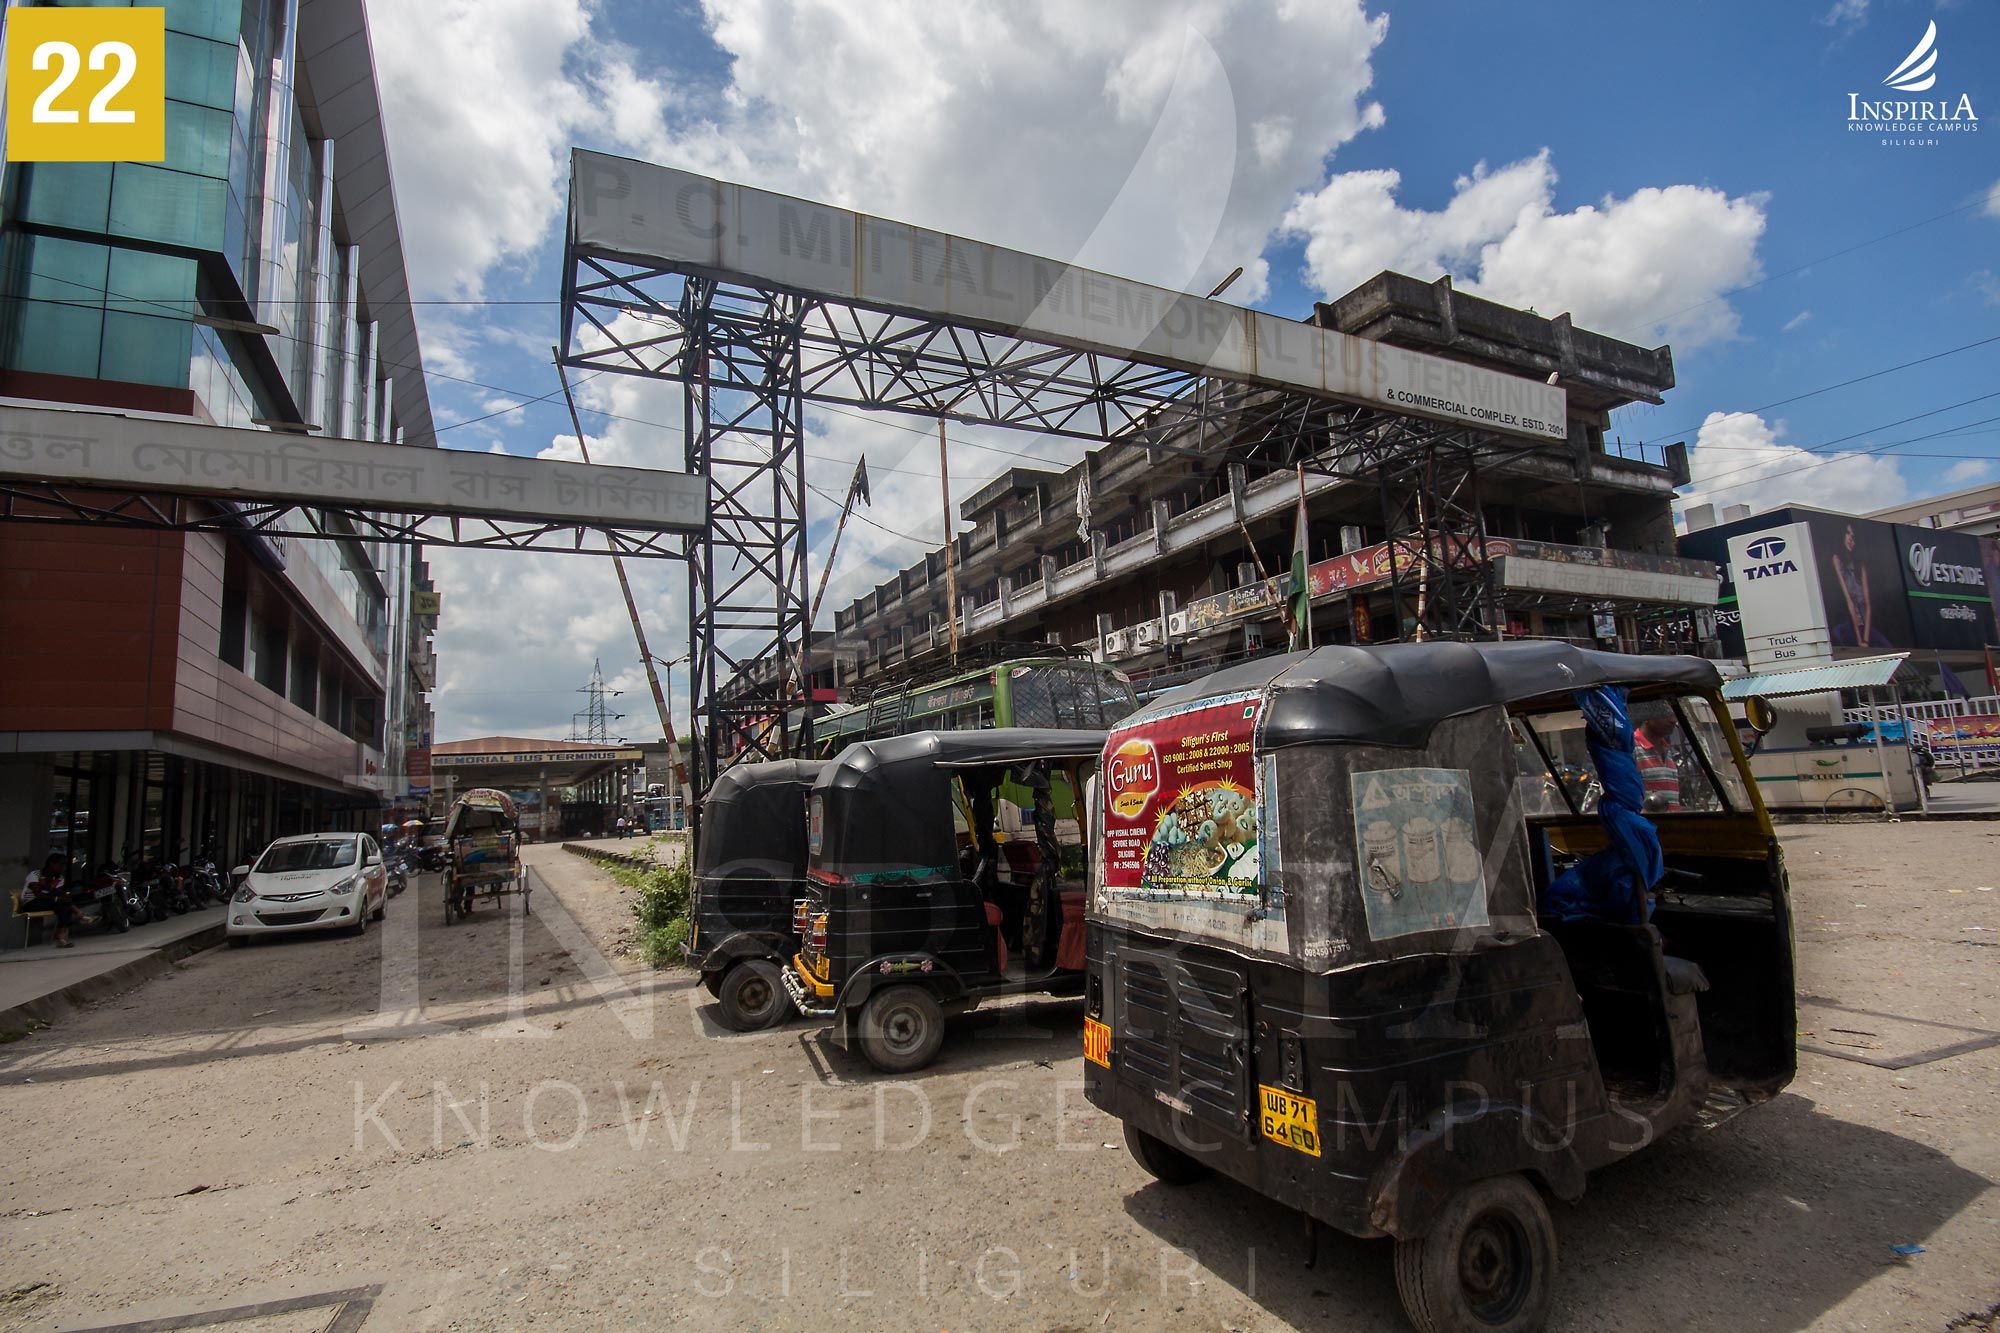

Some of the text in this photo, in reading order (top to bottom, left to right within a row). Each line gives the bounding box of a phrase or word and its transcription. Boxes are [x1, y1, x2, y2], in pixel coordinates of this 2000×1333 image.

[779, 202, 1013, 303] MITTAL
[1034, 262, 1298, 363] MEMORIAL
[1310, 325, 1389, 385] BUS
[1400, 352, 1566, 422] TERMINUS
[1387, 388, 1395, 400] &
[1397, 390, 1469, 416] COMMERCIAL
[449, 466, 532, 508] বাস
[1743, 560, 1798, 581] TATA
[1908, 542, 1985, 588] WESTSIDE
[1767, 634, 1798, 646] Truck
[1774, 648, 1796, 659] Bus
[1181, 729, 1229, 749] Siliguri's First
[433, 752, 616, 766] MEMORIAL BUS TERMINUS
[1163, 754, 1172, 764] ISO
[1209, 746, 1230, 756] 22000
[1233, 742, 1250, 753] 2005
[1111, 760, 1153, 791] Guru
[1177, 759, 1233, 774] Certified Sweet Shop
[1107, 829, 1115, 838] OPP
[1129, 827, 1147, 837] CINEMA
[1128, 839, 1141, 848] ROAD
[1117, 850, 1136, 859] SILIGURI
[1158, 876, 1187, 885] Preparation
[1187, 876, 1208, 885] without
[1233, 877, 1252, 888] Garlic
[1266, 1092, 1308, 1122] WB 71
[1264, 1116, 1315, 1151] 6460
